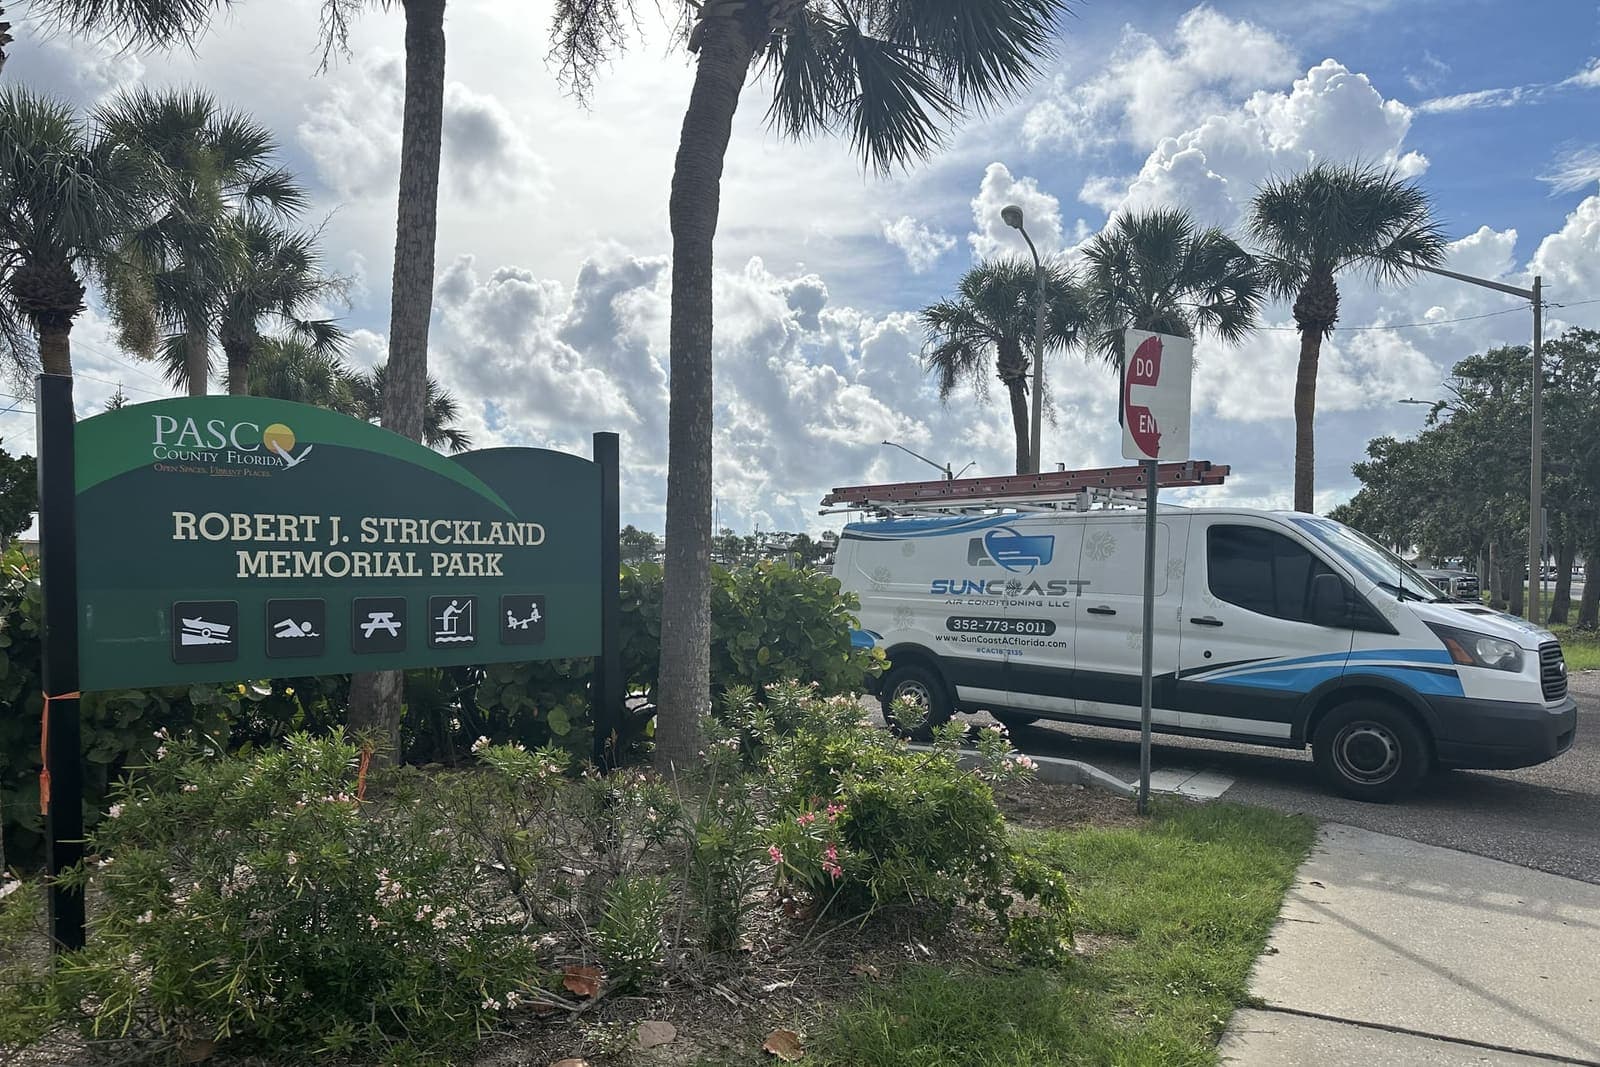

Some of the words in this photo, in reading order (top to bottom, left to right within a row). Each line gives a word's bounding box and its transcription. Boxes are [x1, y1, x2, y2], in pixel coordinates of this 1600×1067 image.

[1136, 358, 1153, 377] DO
[153, 446, 218, 463] COUNTY
[227, 450, 284, 467] FLORIDA
[172, 511, 320, 542] ROBERT
[329, 516, 350, 546] J.
[360, 517, 546, 546] STRICKLAND
[236, 550, 423, 578] MEMORIAL
[431, 553, 504, 577] PARK
[930, 578, 1091, 597] SUNCOAST
[967, 599, 1043, 607] CONDITIONING
[1048, 600, 1070, 608] LLC
[953, 619, 1047, 634] 352-773-6011
